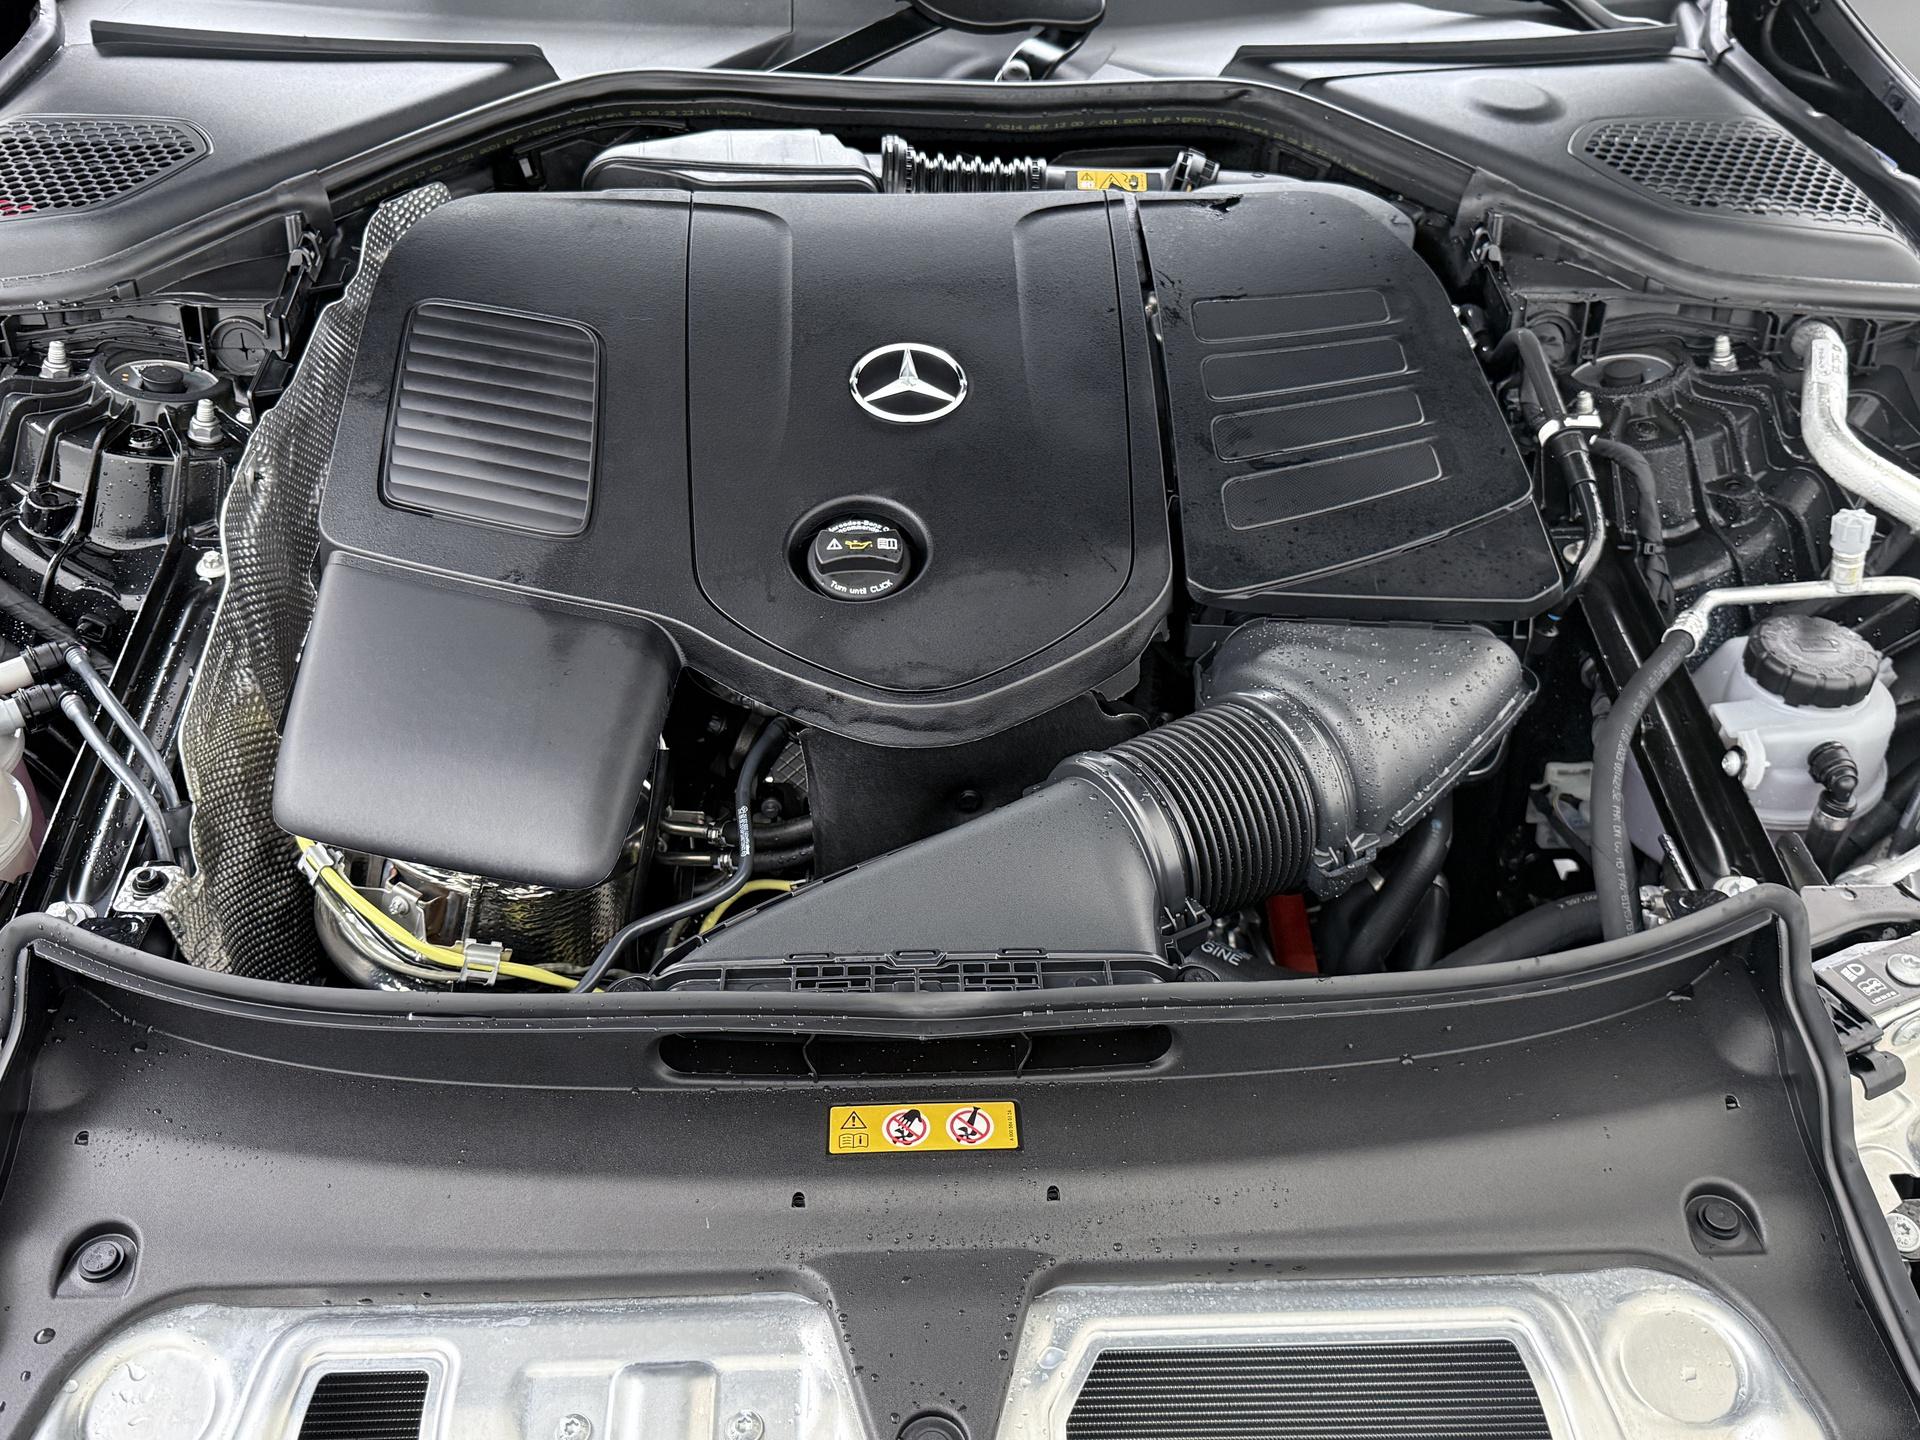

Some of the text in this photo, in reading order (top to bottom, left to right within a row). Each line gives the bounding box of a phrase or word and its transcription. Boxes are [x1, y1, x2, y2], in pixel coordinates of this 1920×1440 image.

[830, 579, 894, 595] Turn until CLICK
